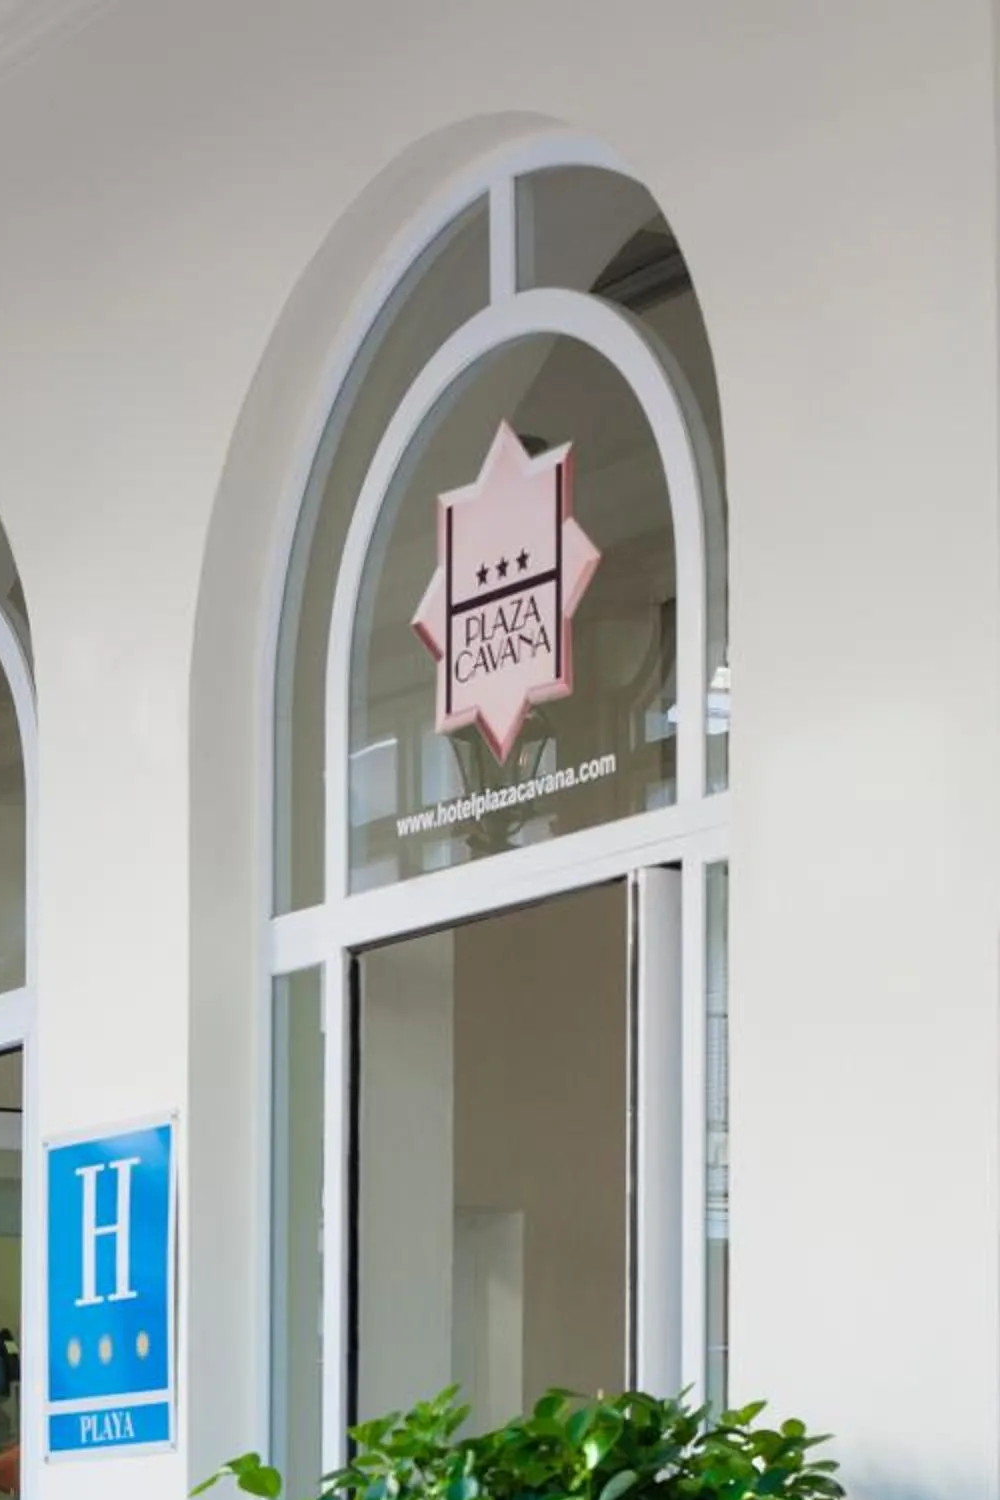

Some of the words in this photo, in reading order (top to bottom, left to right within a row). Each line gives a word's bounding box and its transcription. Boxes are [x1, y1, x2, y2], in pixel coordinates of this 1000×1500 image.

[466, 595, 541, 649] PLAZA
[455, 625, 551, 683] CAVANA
[396, 754, 616, 837] www.hotelplazacavana.com
[74, 1156, 141, 1307] H
[80, 1411, 135, 1444] PLAYA
